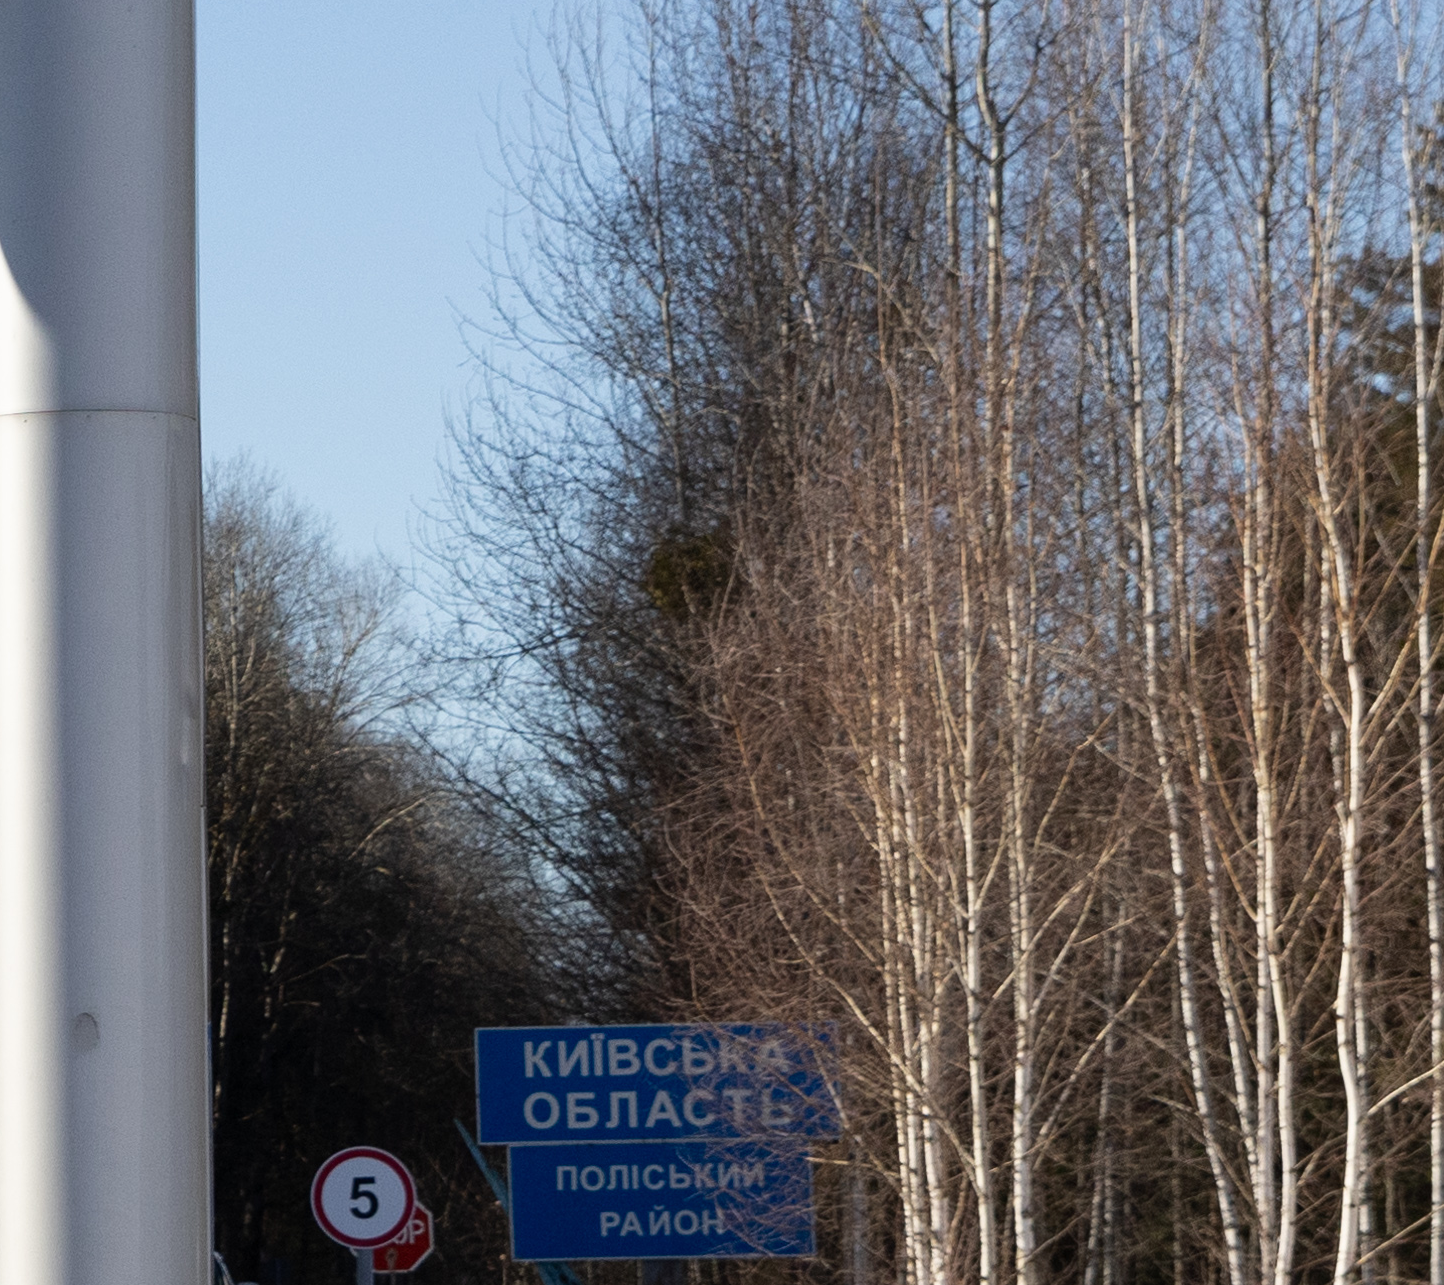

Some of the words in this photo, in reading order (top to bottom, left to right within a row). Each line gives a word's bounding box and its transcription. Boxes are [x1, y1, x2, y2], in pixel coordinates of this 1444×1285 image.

[523, 1032, 791, 1078] КИЇВСЬКА
[523, 1089, 794, 1130] ОБЛАСТЬ
[349, 1176, 379, 1219] 5
[599, 1205, 726, 1237] РАЙОН
